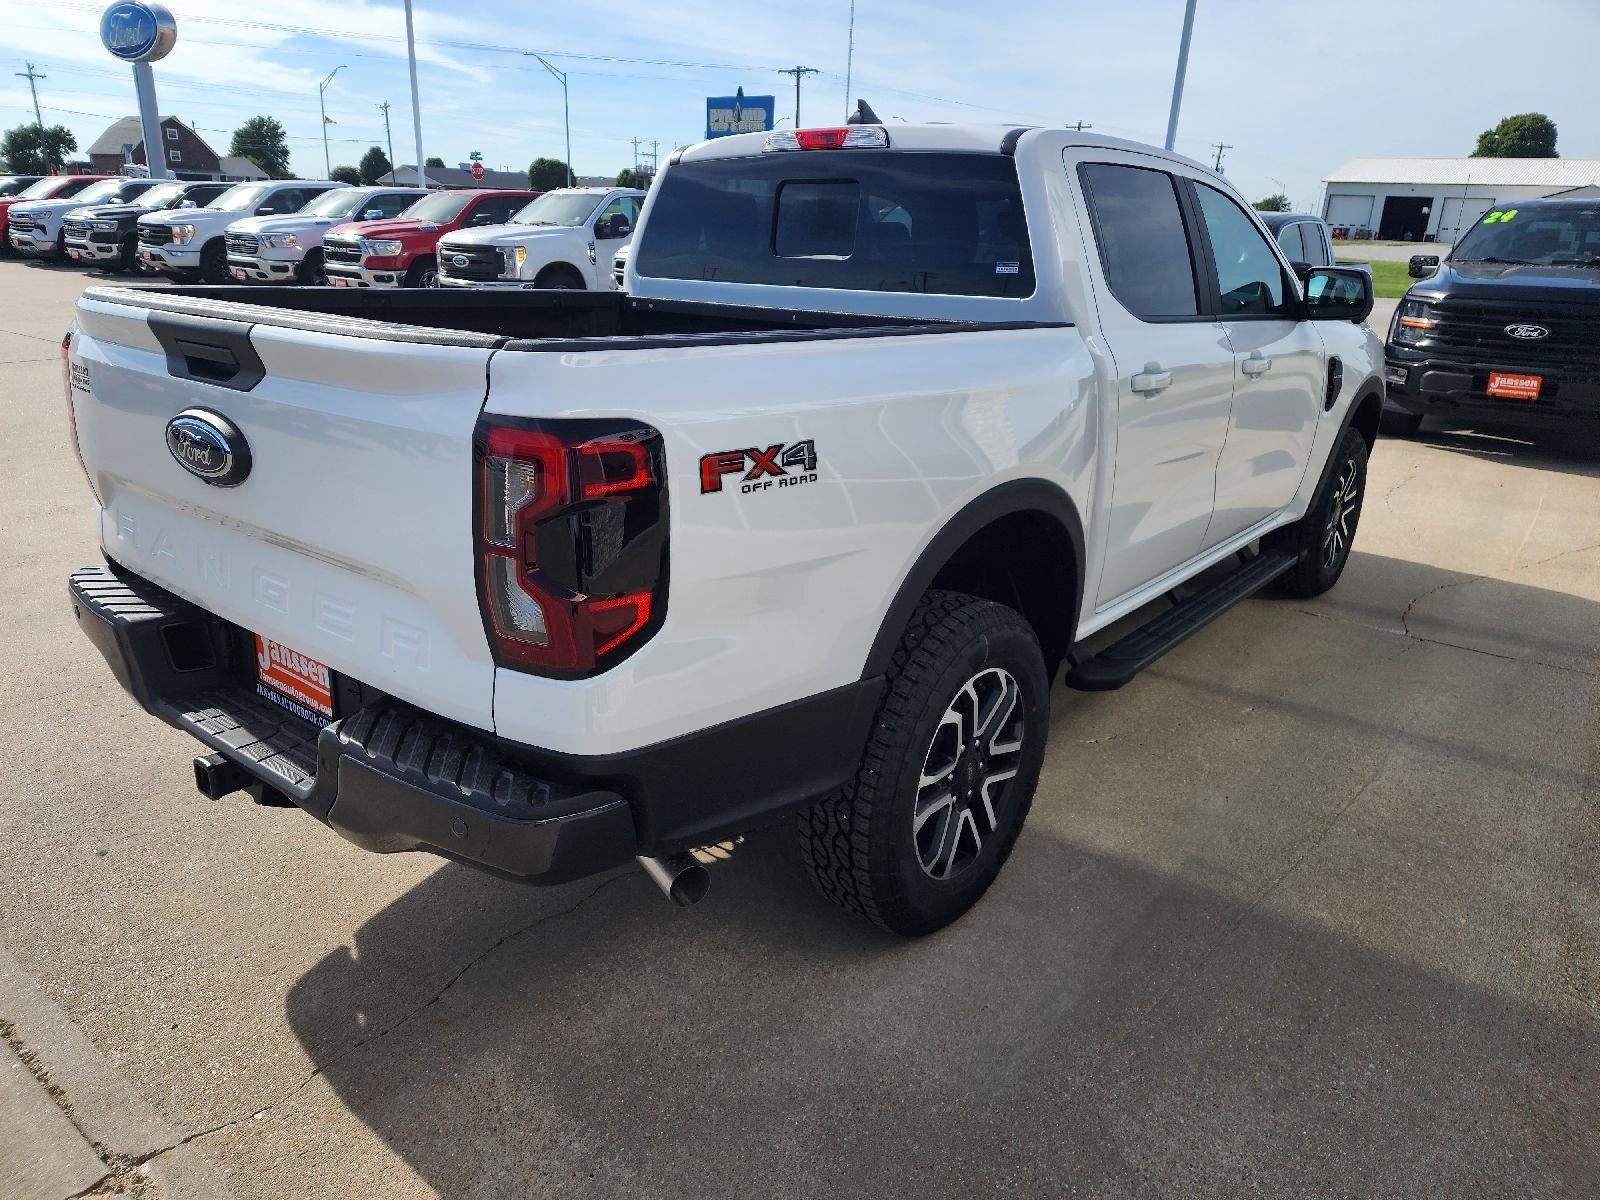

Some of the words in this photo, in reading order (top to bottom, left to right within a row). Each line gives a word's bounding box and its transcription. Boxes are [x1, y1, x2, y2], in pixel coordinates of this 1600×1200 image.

[110, 12, 145, 48] Ford
[1514, 327, 1540, 337] Ford
[1490, 376, 1537, 388] Janssen
[177, 429, 212, 466] Ford
[699, 439, 818, 495] FX4
[741, 480, 773, 494] OFF
[779, 473, 818, 488] ROAD
[117, 505, 431, 673] RANGER
[258, 636, 330, 689] Janssen
